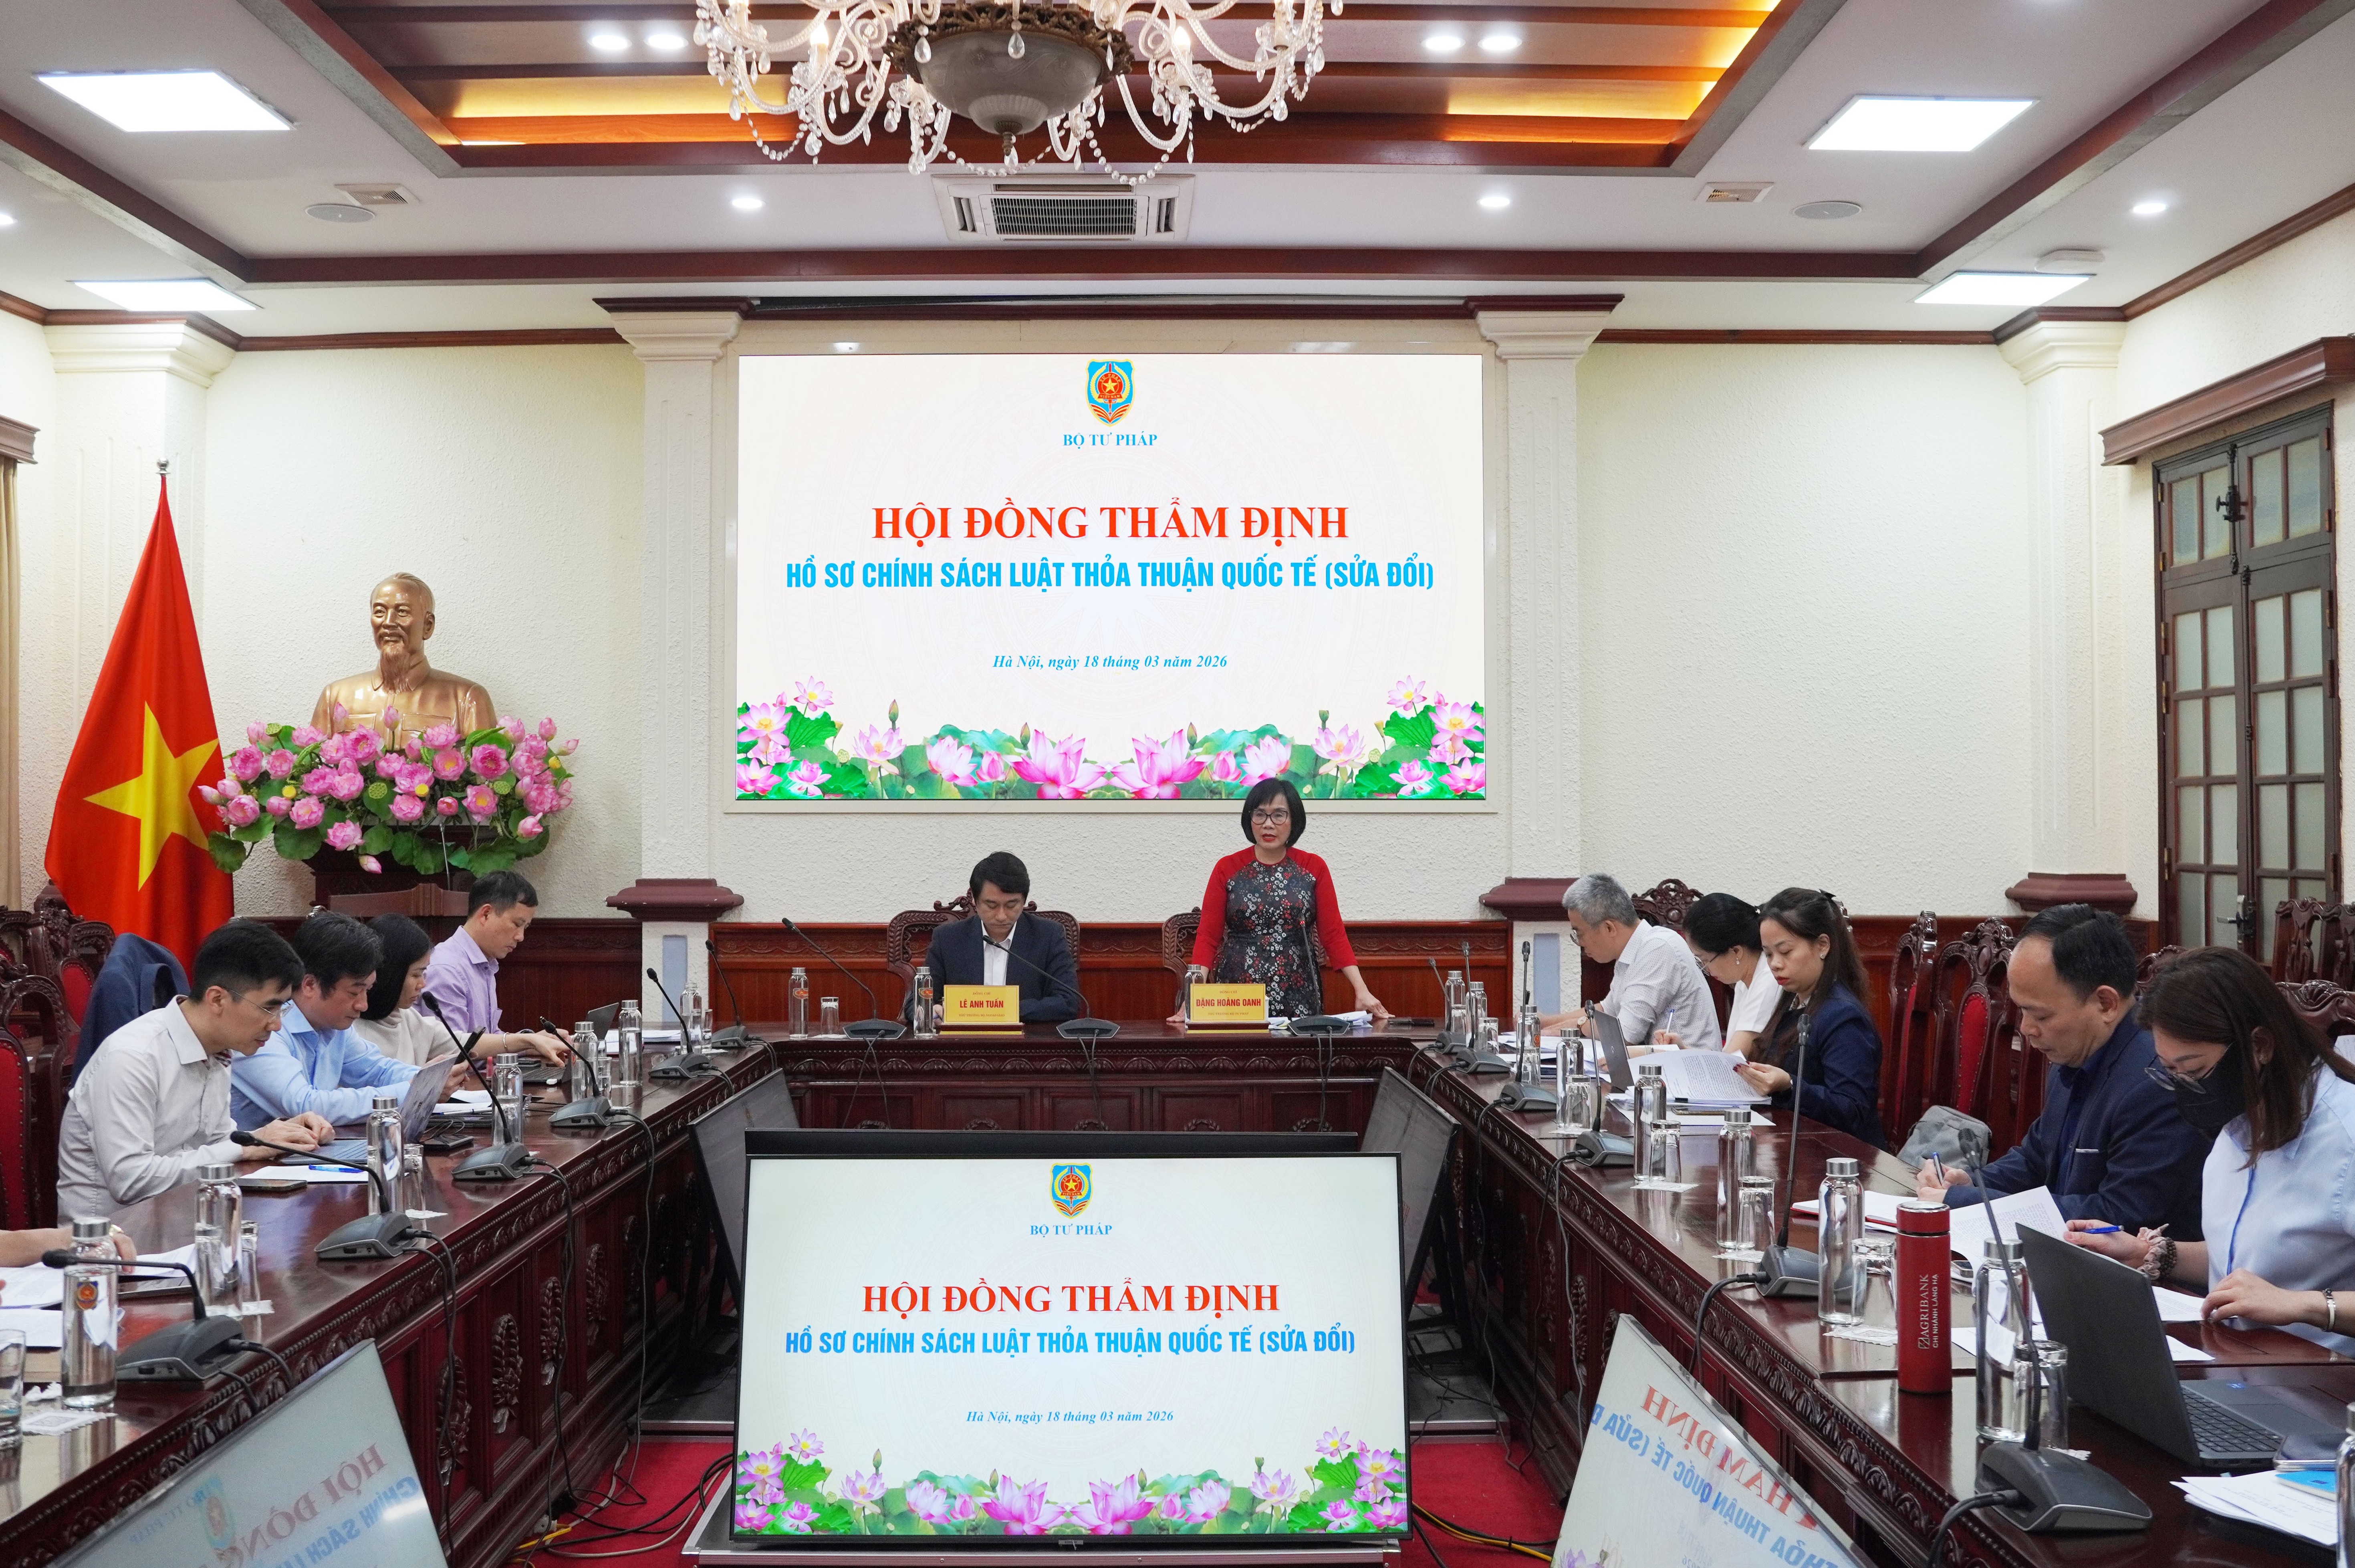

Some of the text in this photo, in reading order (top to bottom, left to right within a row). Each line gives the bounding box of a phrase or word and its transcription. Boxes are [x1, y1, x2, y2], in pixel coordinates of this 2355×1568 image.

[1063, 431, 1157, 449] BỘ TƯ PHÁP
[872, 498, 1349, 547] HỘI ĐỒNG THẨM ĐỊNH
[787, 552, 1433, 593] HỒ SƠ CHÍNH SÁCH LUẬT THỎA THUẬN QUỐC TẾ (SỬA ĐỔI)
[993, 655, 1228, 671] Hà Nội, ngày 18 tháng 03 năm 2026
[960, 999, 968, 1008] LÊ
[986, 998, 1004, 1008] TUẤN
[1196, 998, 1215, 1008] ĐẶNG
[1217, 997, 1240, 1006] HOÀNG
[1030, 1222, 1112, 1237] BỘ TƯ PHÁP
[1932, 1274, 1939, 1284] HẠ
[862, 1278, 1280, 1319] HỘI ĐỒNG THẨM ĐỊNH
[1920, 1274, 1930, 1338] AGRIBANK
[786, 1322, 1355, 1358] HỒ SƠ CHÍNH SÁCH LUẬT THỎA THUẬN QUỐC TẾ (SỬA ĐỔI)
[967, 1411, 1173, 1425] Hà Nội, ngày 18 tháng 03 năm 2026
